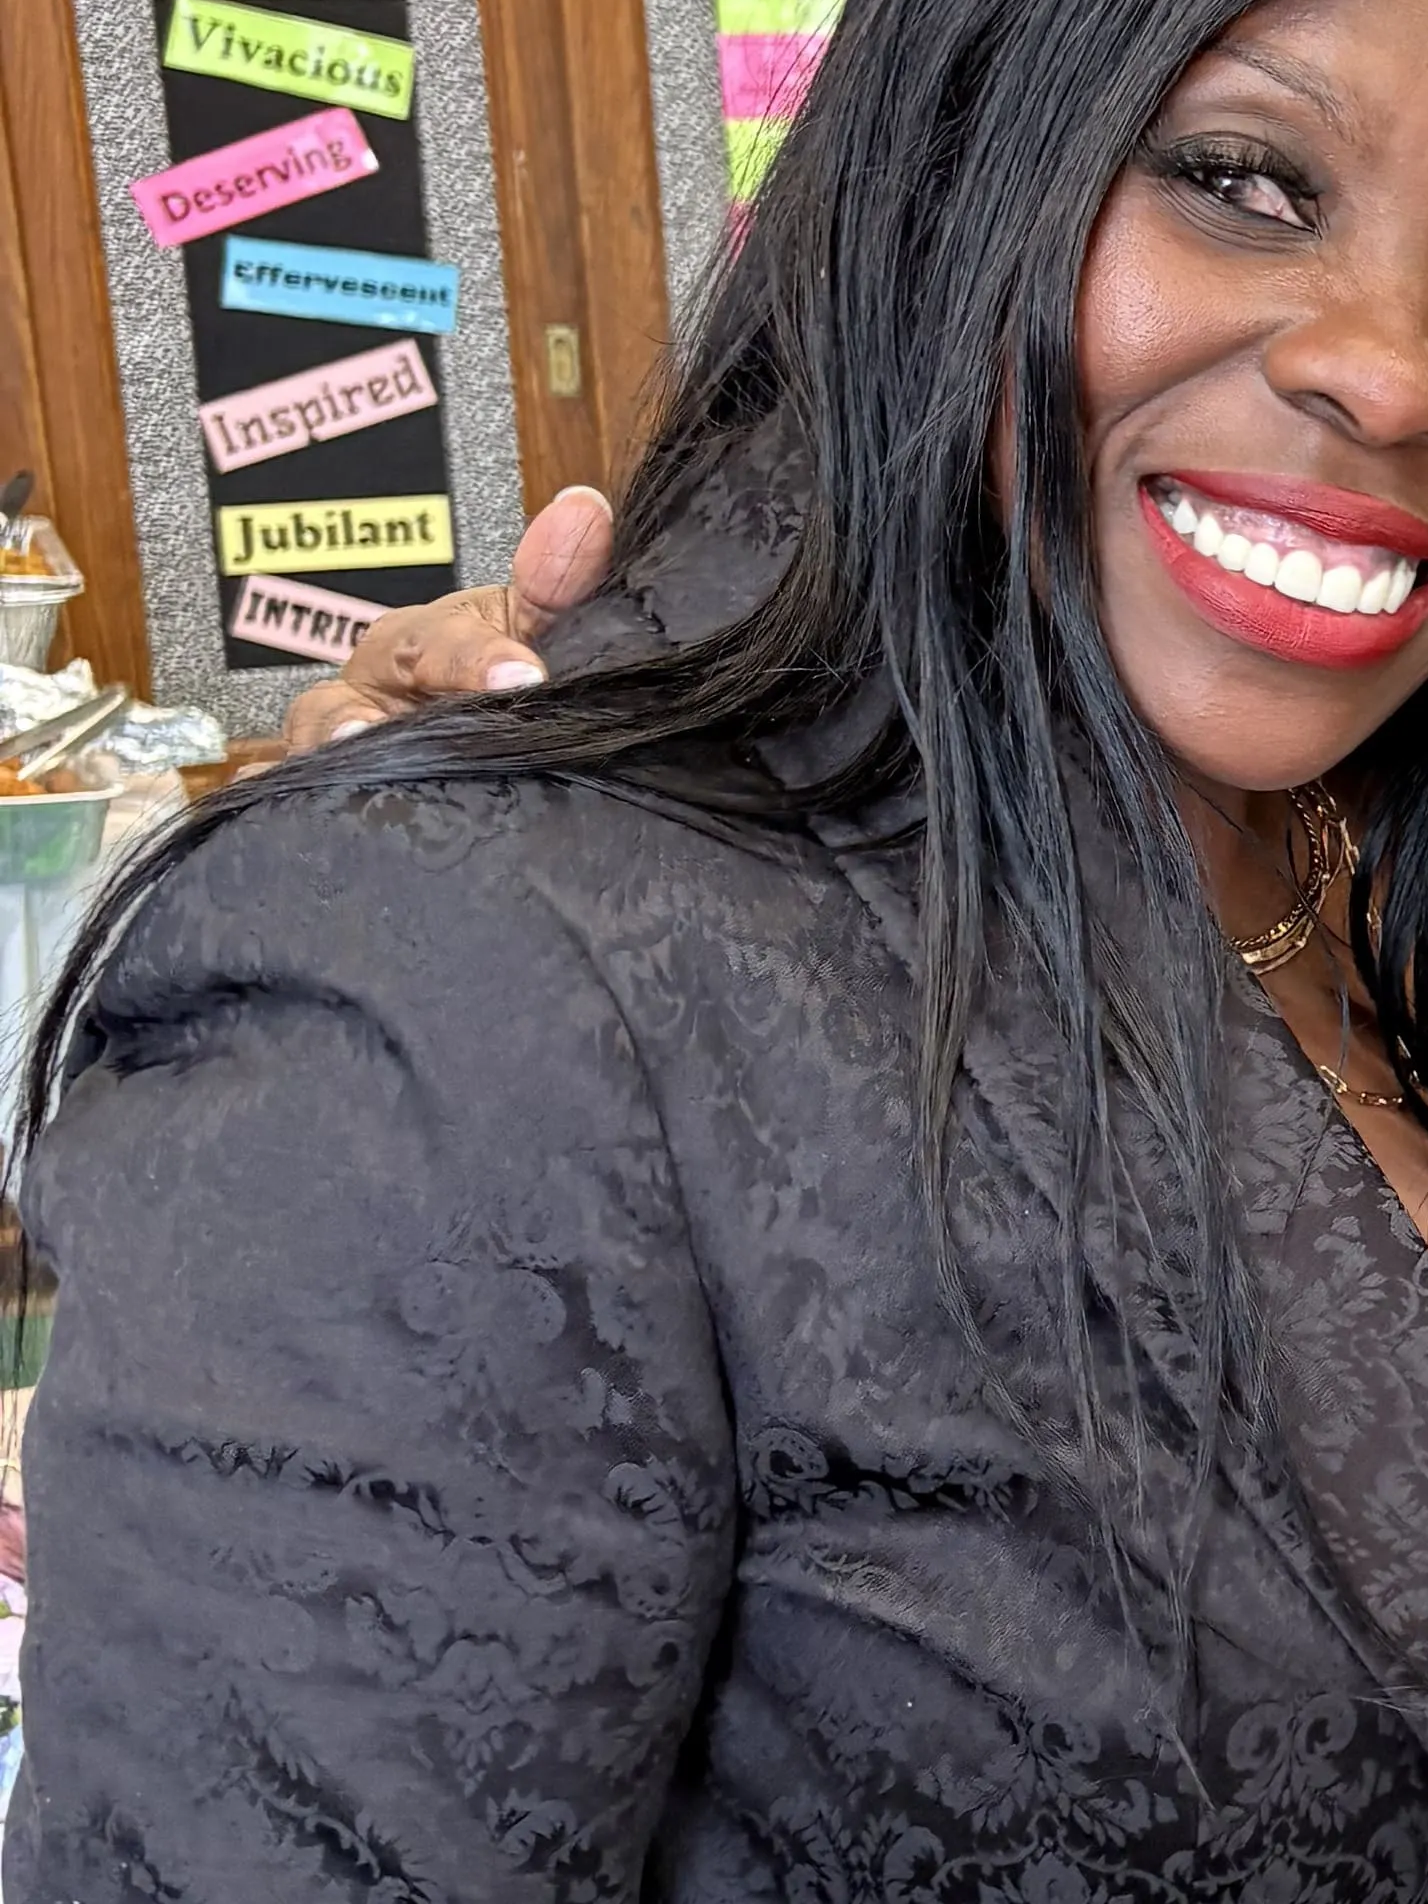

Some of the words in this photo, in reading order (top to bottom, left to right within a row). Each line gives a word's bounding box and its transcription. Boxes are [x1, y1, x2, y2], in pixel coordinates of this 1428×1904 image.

[181, 15, 405, 99] Vivacious
[160, 134, 354, 226] Deserving
[232, 257, 454, 310] Effervescent
[211, 354, 428, 452] Inspired
[233, 507, 435, 563] Jubilant
